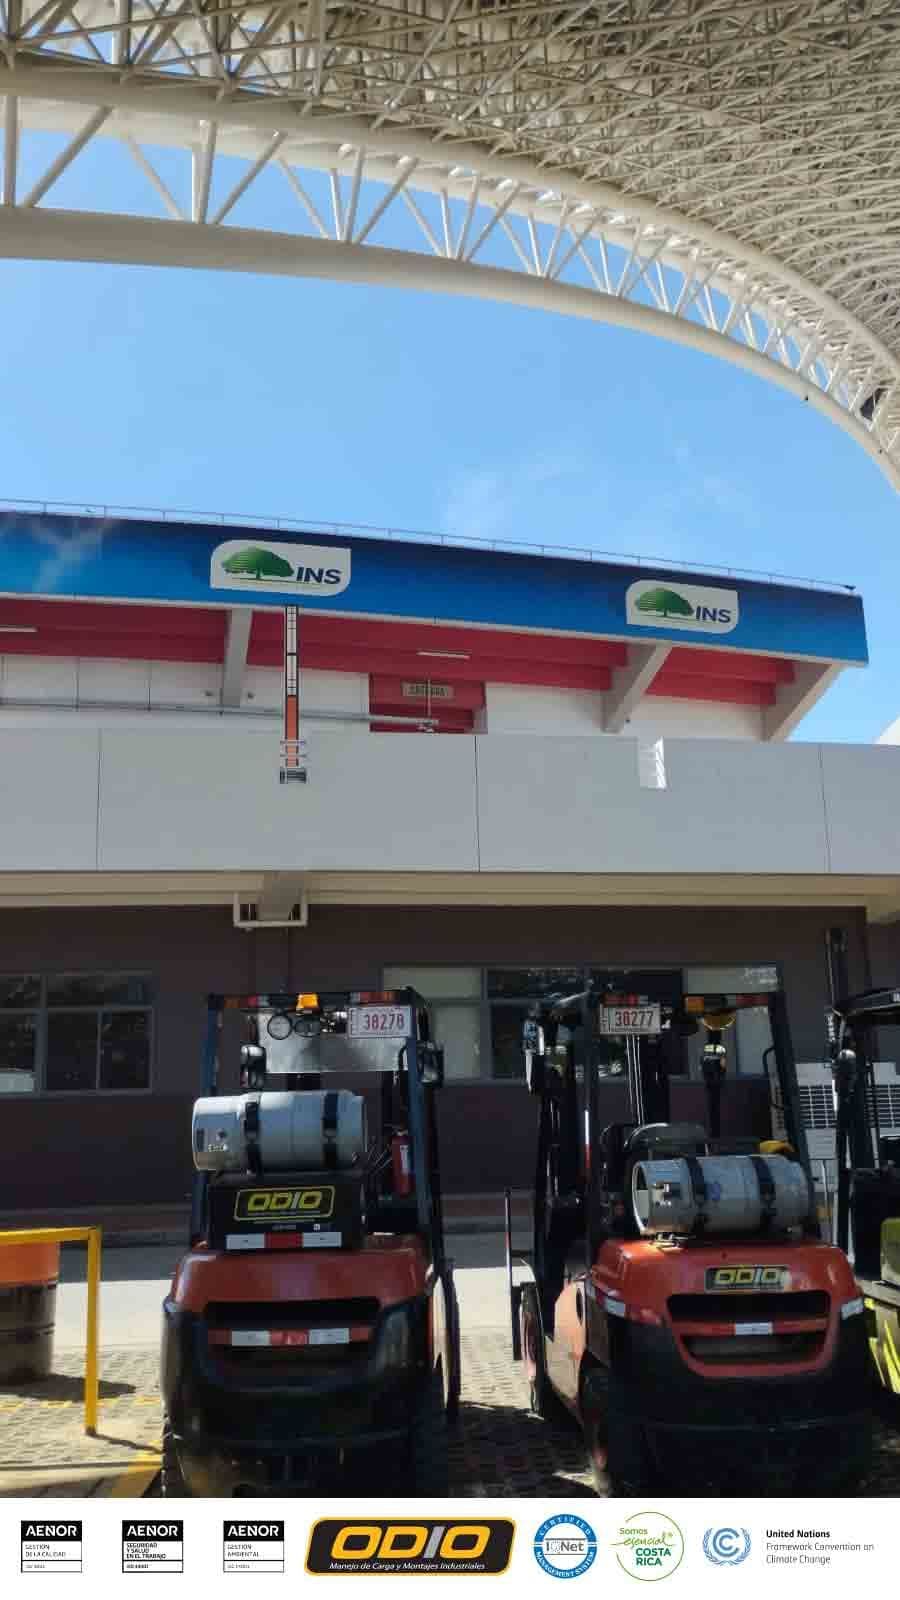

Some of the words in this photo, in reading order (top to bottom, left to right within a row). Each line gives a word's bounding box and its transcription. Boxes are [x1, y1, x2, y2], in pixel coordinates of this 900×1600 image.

[296, 566, 342, 585] INS
[695, 606, 732, 624] INS
[247, 1190, 321, 1211] ODIO
[714, 1267, 779, 1284] ODIO
